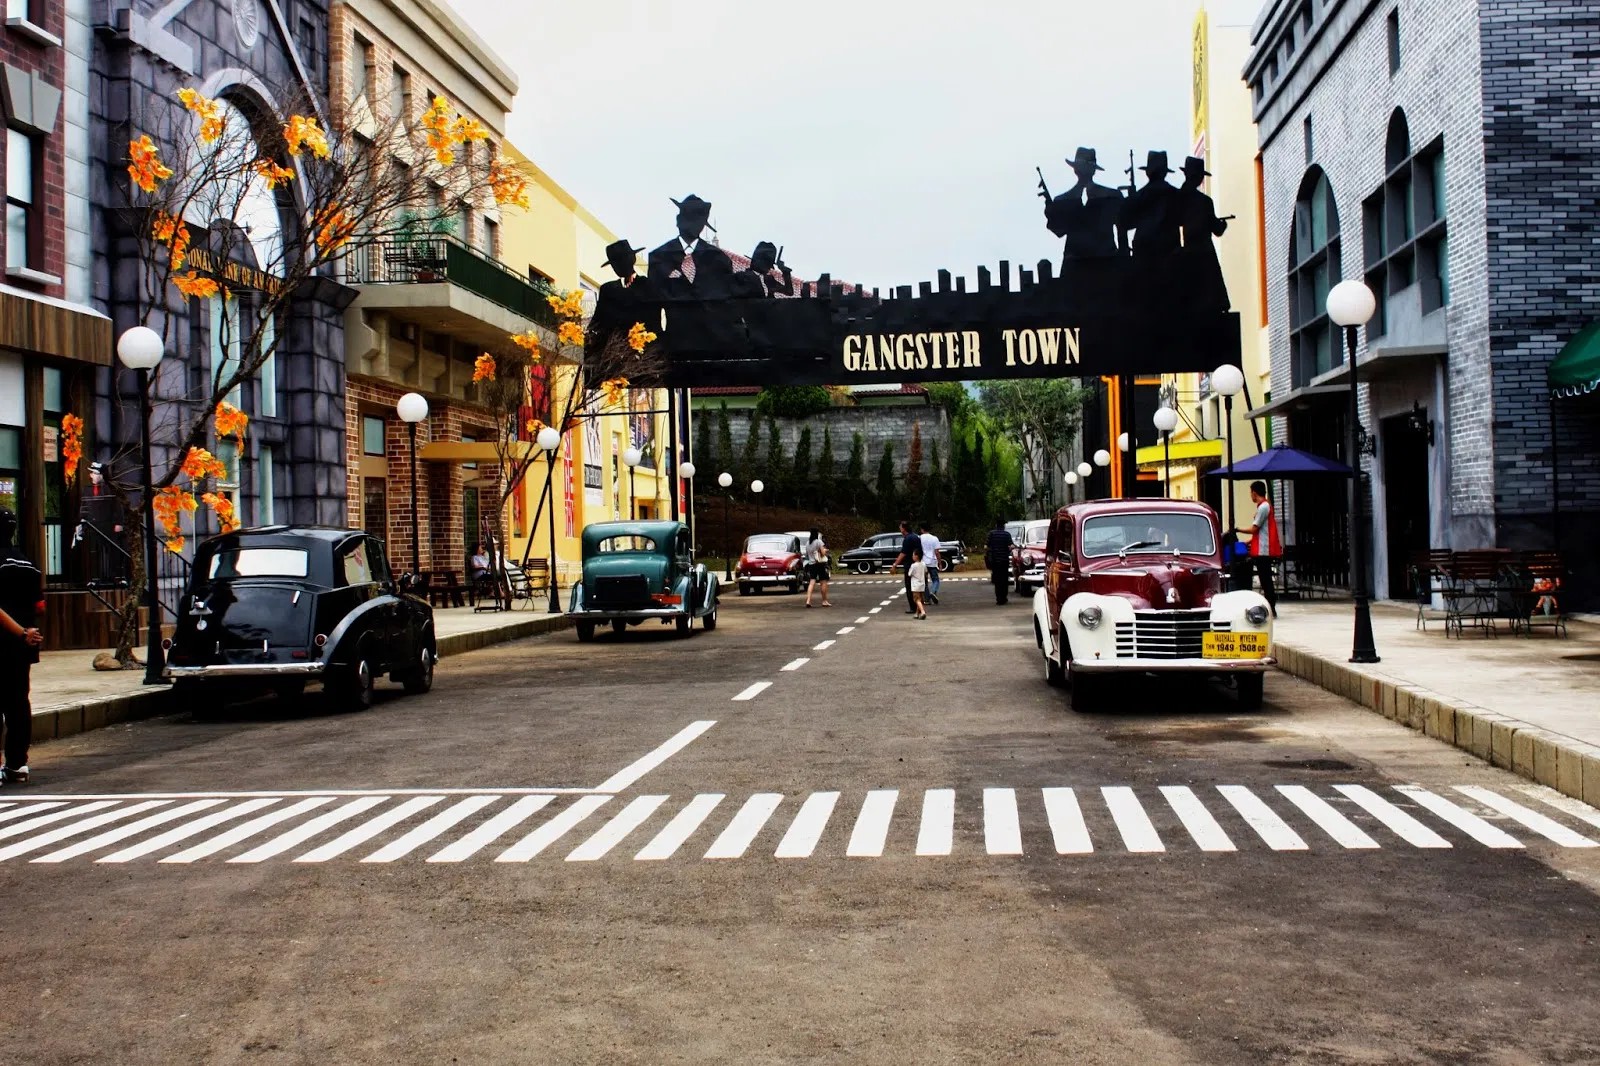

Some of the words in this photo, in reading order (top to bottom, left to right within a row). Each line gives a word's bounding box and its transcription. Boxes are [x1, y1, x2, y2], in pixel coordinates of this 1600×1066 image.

[843, 331, 982, 371] GANGSTER
[1002, 328, 1080, 366] TOWN
[1217, 643, 1234, 652] 1949
